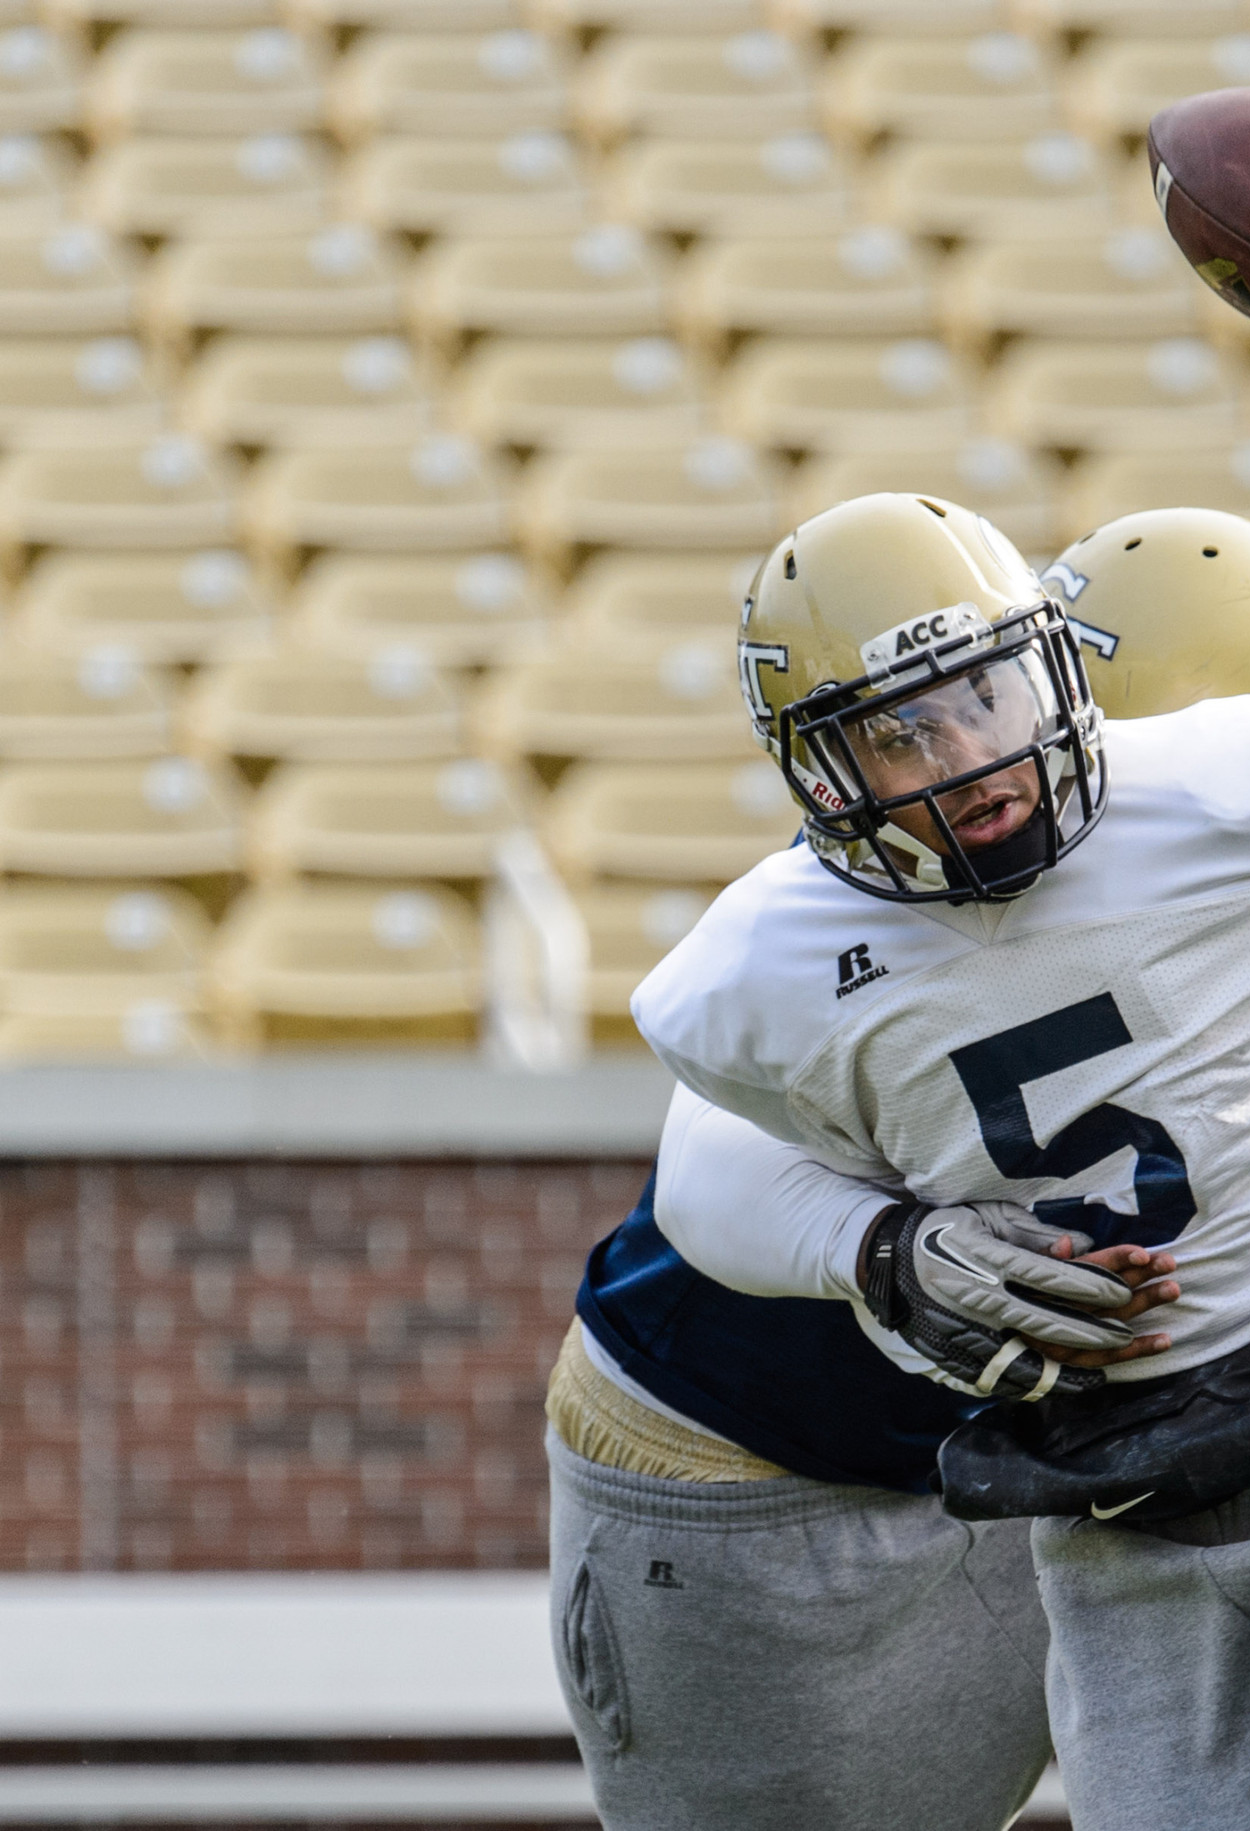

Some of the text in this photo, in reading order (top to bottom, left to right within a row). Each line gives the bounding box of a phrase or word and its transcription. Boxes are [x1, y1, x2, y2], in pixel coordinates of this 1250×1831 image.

[895, 614, 948, 656] ACC
[836, 965, 890, 999] RUSSELL
[948, 991, 1198, 1251] 5
